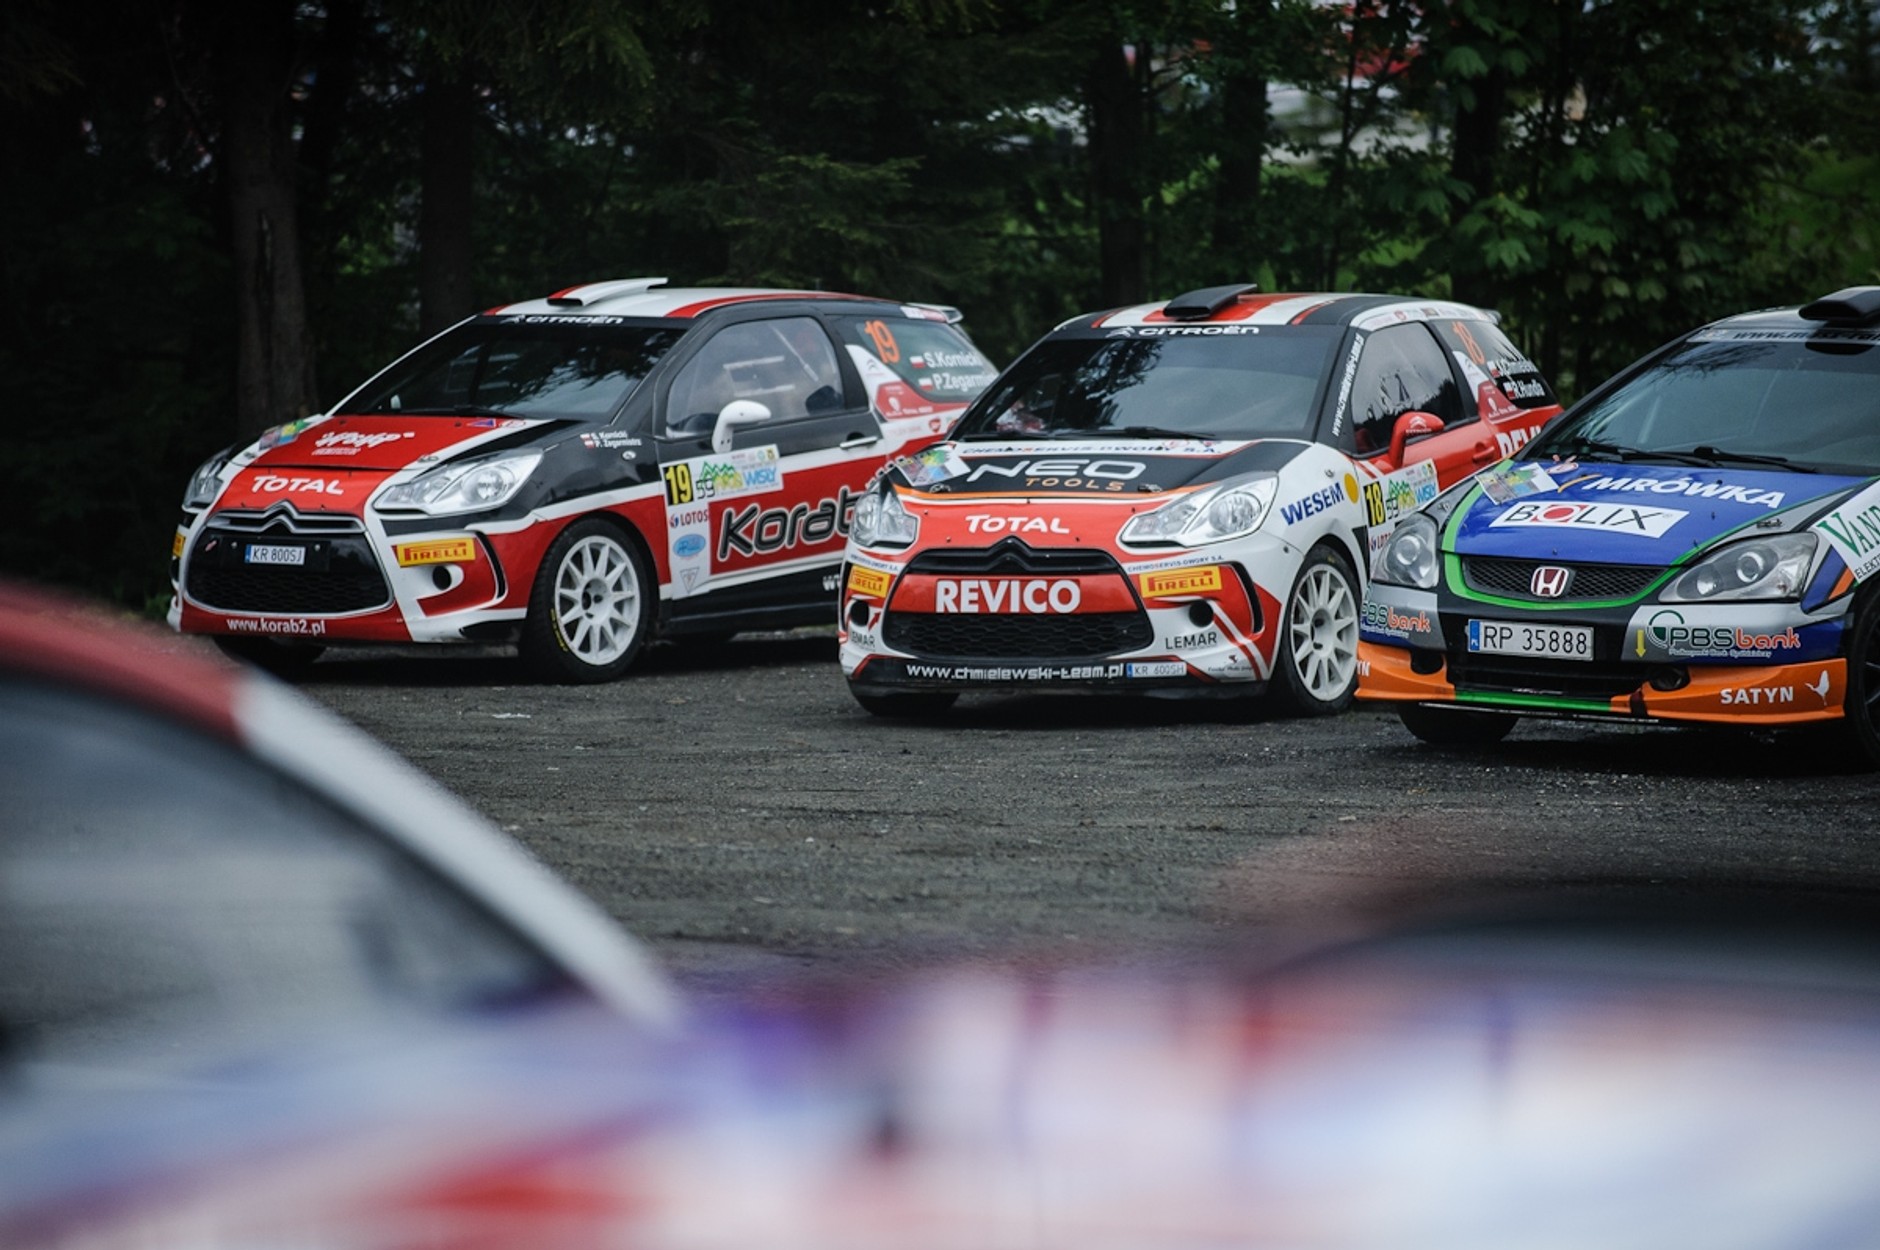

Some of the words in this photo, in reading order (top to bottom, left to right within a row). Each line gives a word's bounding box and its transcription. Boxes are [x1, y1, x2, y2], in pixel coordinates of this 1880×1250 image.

[864, 320, 900, 364] 19
[1452, 320, 1486, 365] 18
[966, 459, 1146, 483] NEO
[251, 474, 344, 495] TOTAL
[665, 463, 692, 505] 19
[695, 477, 716, 500] 59
[1025, 478, 1125, 492] TOOLS
[1581, 474, 1786, 509] MRÓWKA
[1281, 482, 1345, 526] WESEM
[1366, 482, 1387, 526] 18
[681, 505, 709, 526] LOTOS
[965, 514, 1070, 534] TOTAL
[1504, 503, 1664, 531] BOLIX
[252, 546, 269, 560] KR
[404, 541, 467, 561] PIRELLI
[1147, 570, 1214, 592] PIRELLI
[936, 579, 1081, 614] REVICO
[226, 618, 326, 636] www.korab2.pl
[1165, 631, 1218, 650] LEMAR
[1483, 625, 1513, 649] RP
[1522, 628, 1587, 655] 35888
[906, 662, 1124, 680] www.chmielewski-team.pl
[1135, 665, 1148, 675] KR
[1719, 685, 1794, 705] SATYN
